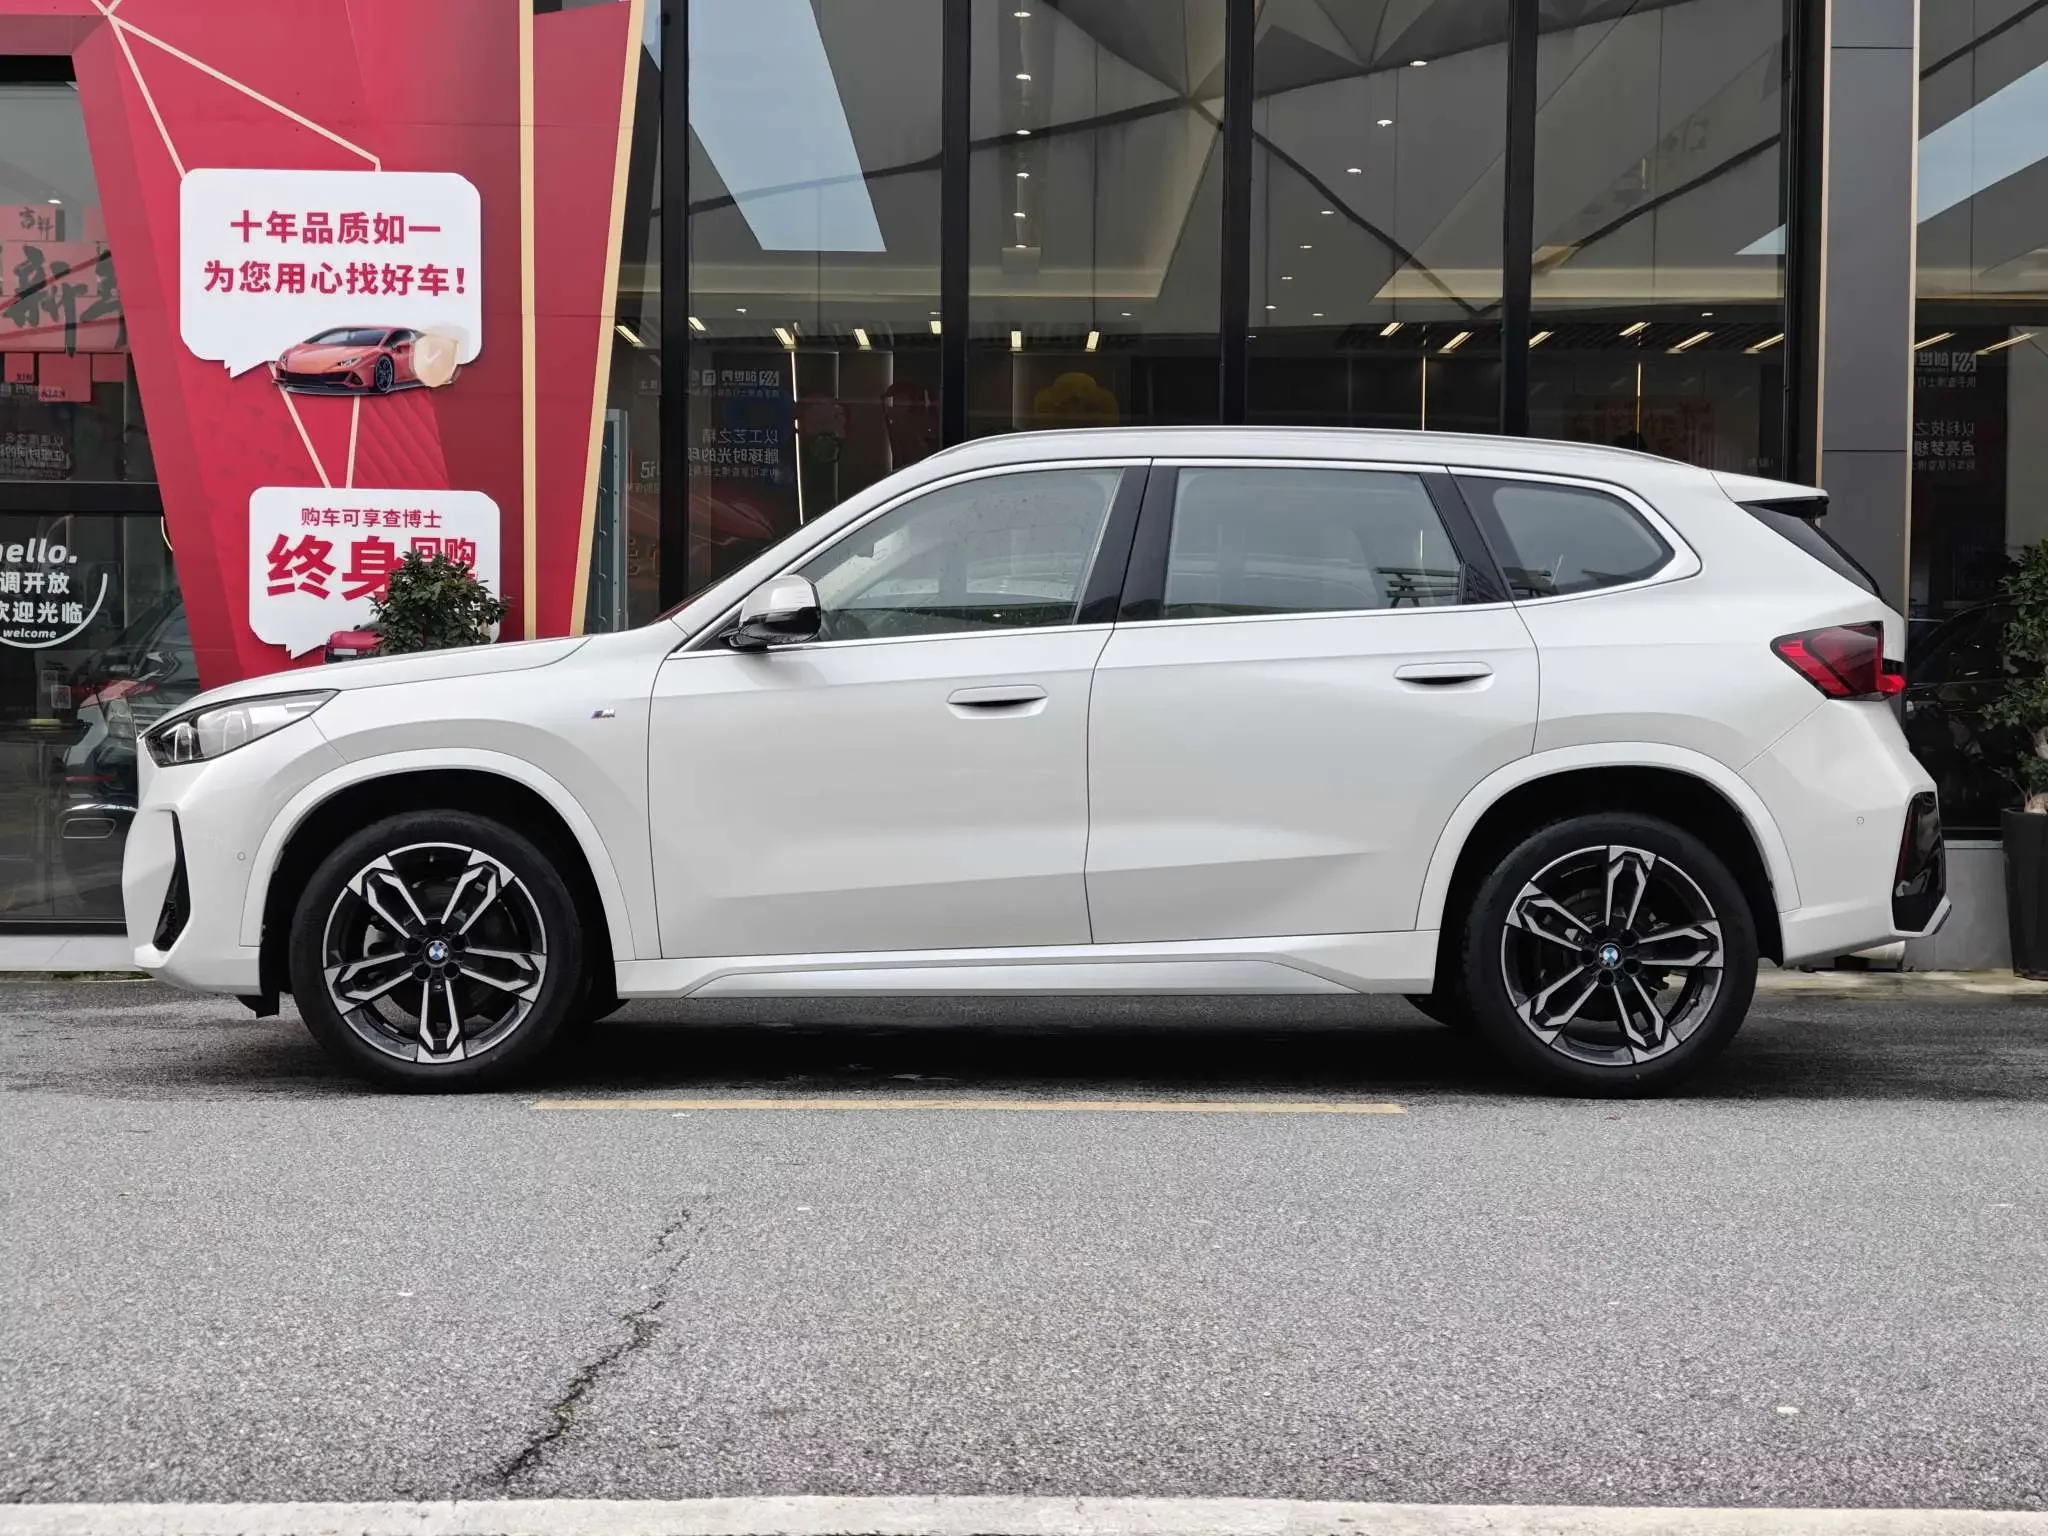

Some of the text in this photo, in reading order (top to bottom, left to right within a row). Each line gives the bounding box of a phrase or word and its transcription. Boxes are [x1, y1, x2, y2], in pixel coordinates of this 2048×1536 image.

[231, 209, 441, 245] 十年品质如一
[301, 507, 441, 529] 购车可享查博士
[0, 538, 78, 564] ello.
[266, 533, 403, 601] 终身
[0, 571, 70, 595] 调开放
[2, 627, 57, 639] welcome
